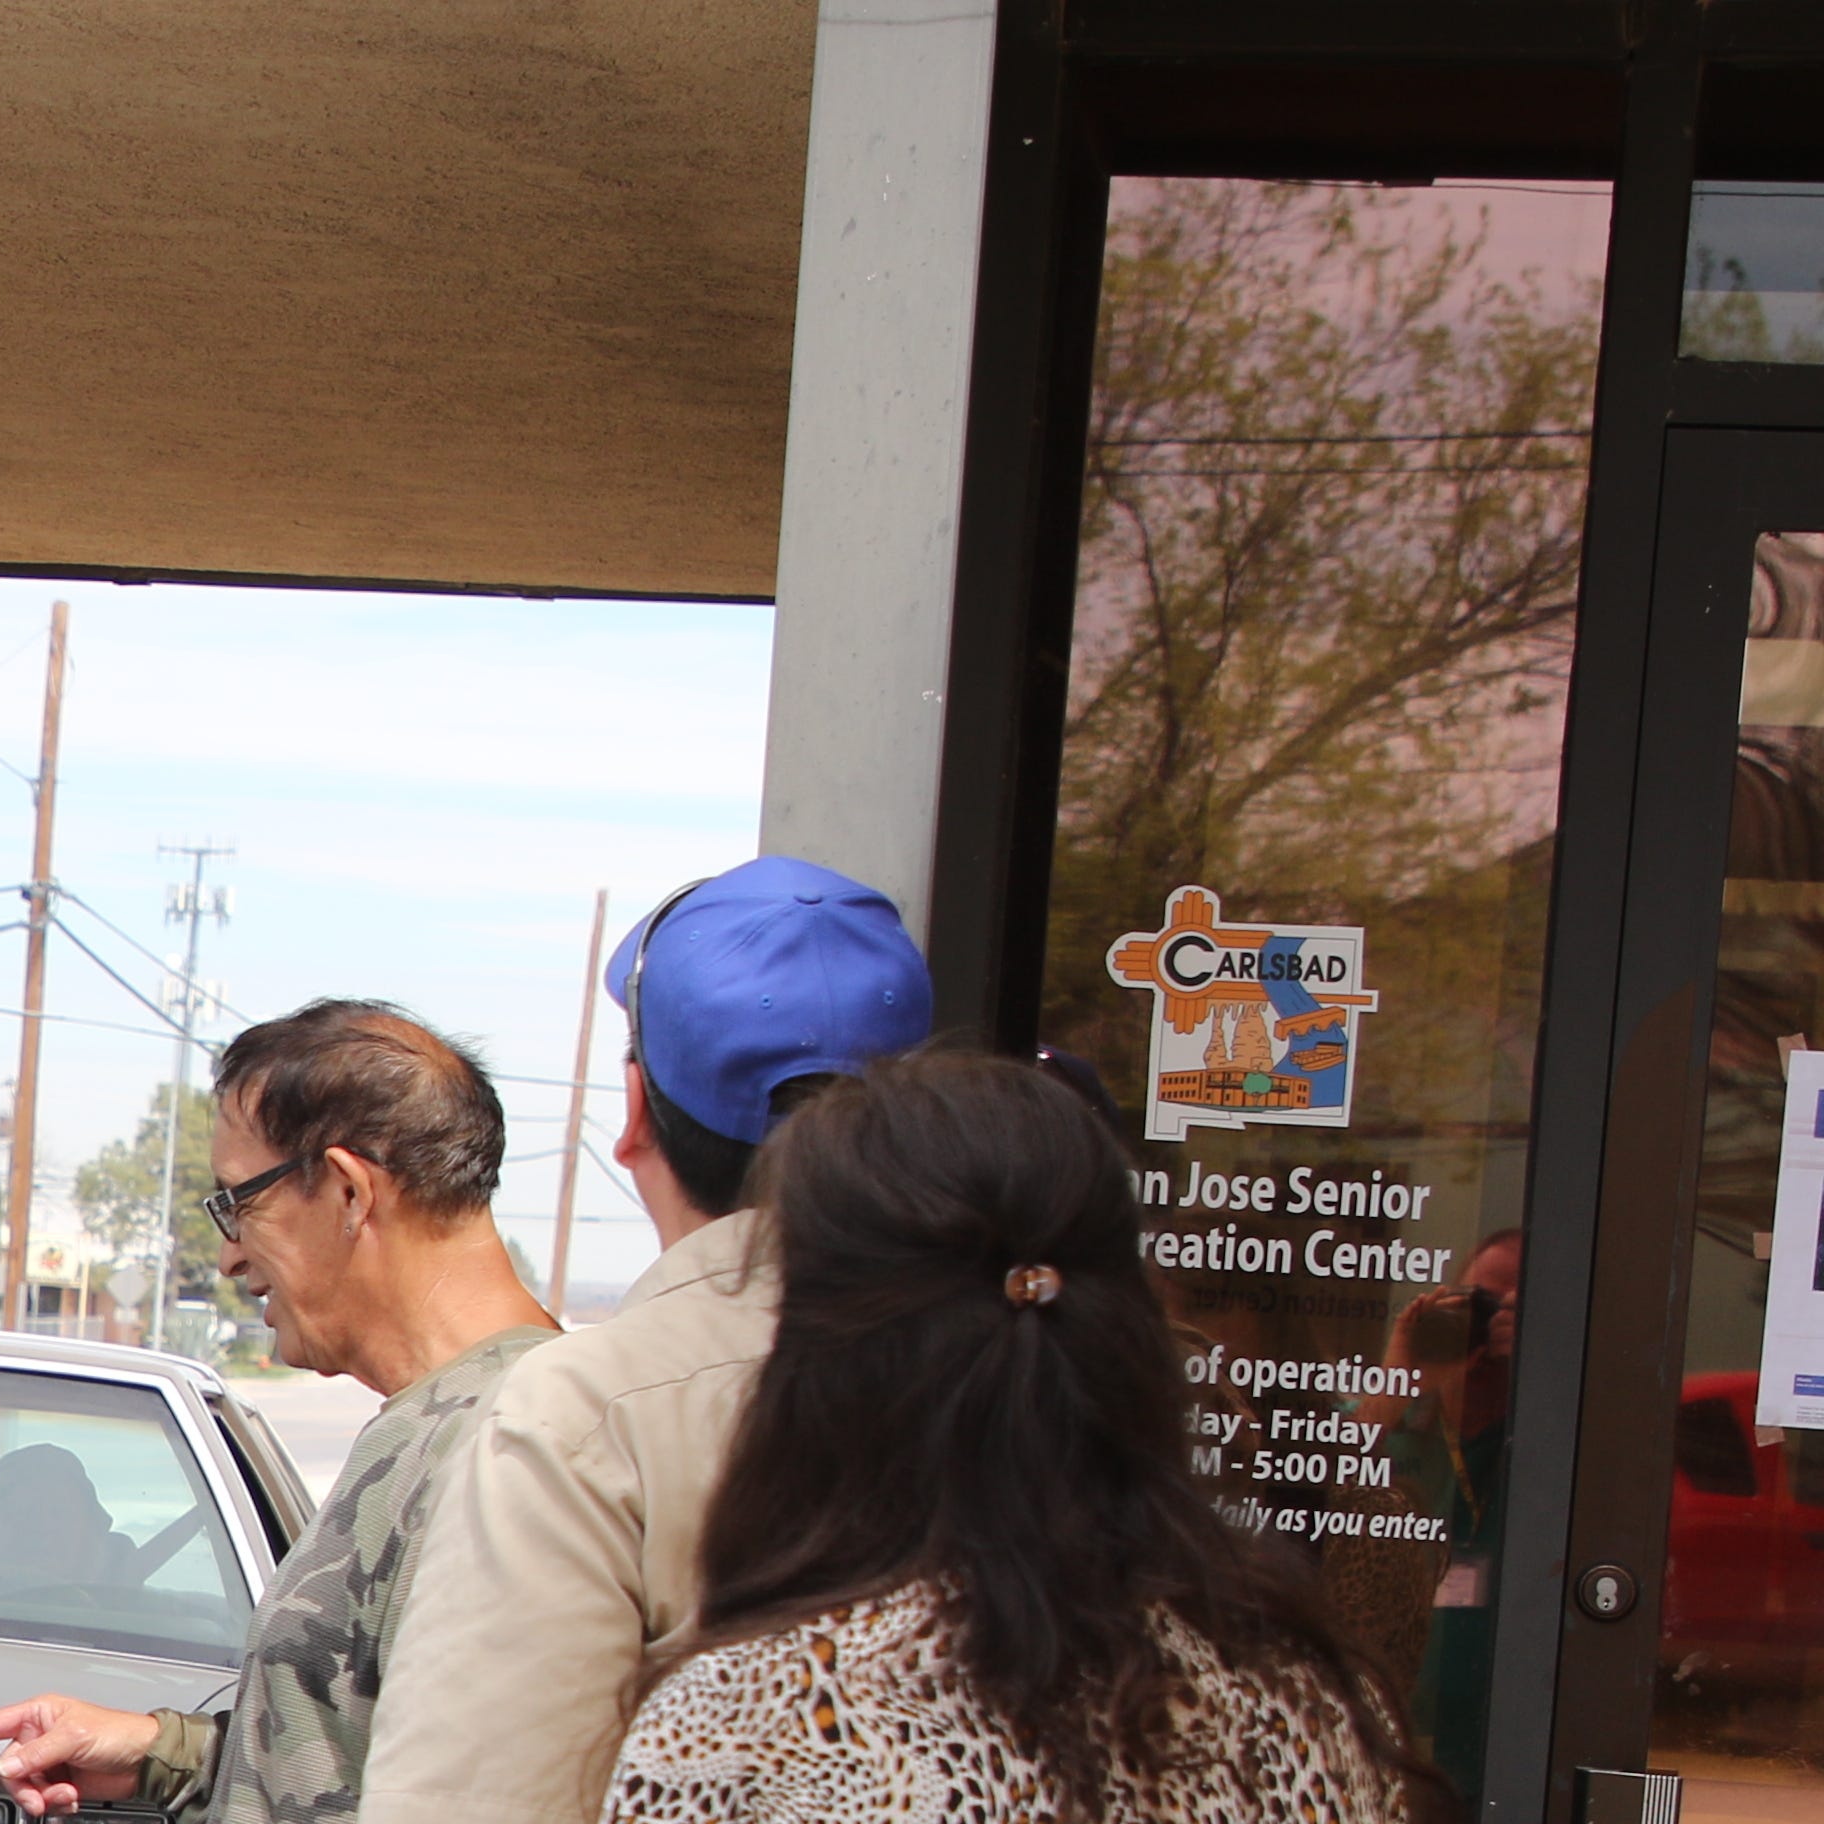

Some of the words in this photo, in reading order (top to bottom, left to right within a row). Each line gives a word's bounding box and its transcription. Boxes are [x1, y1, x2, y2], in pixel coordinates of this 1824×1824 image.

[1164, 935, 1347, 986] CARLSBAD
[1178, 1161, 1276, 1212] Jose
[1286, 1166, 1431, 1220] Senior
[1139, 1223, 1292, 1274] reation
[1304, 1229, 1451, 1283] Center
[1184, 1344, 1225, 1384] of
[1230, 1354, 1421, 1398] operation:
[1270, 1409, 1382, 1453] Friday
[1252, 1451, 1327, 1484] 5:00
[1336, 1455, 1391, 1488] PM
[1275, 1508, 1307, 1532] as
[1309, 1510, 1363, 1542] you
[1368, 1511, 1448, 1542] enter.
